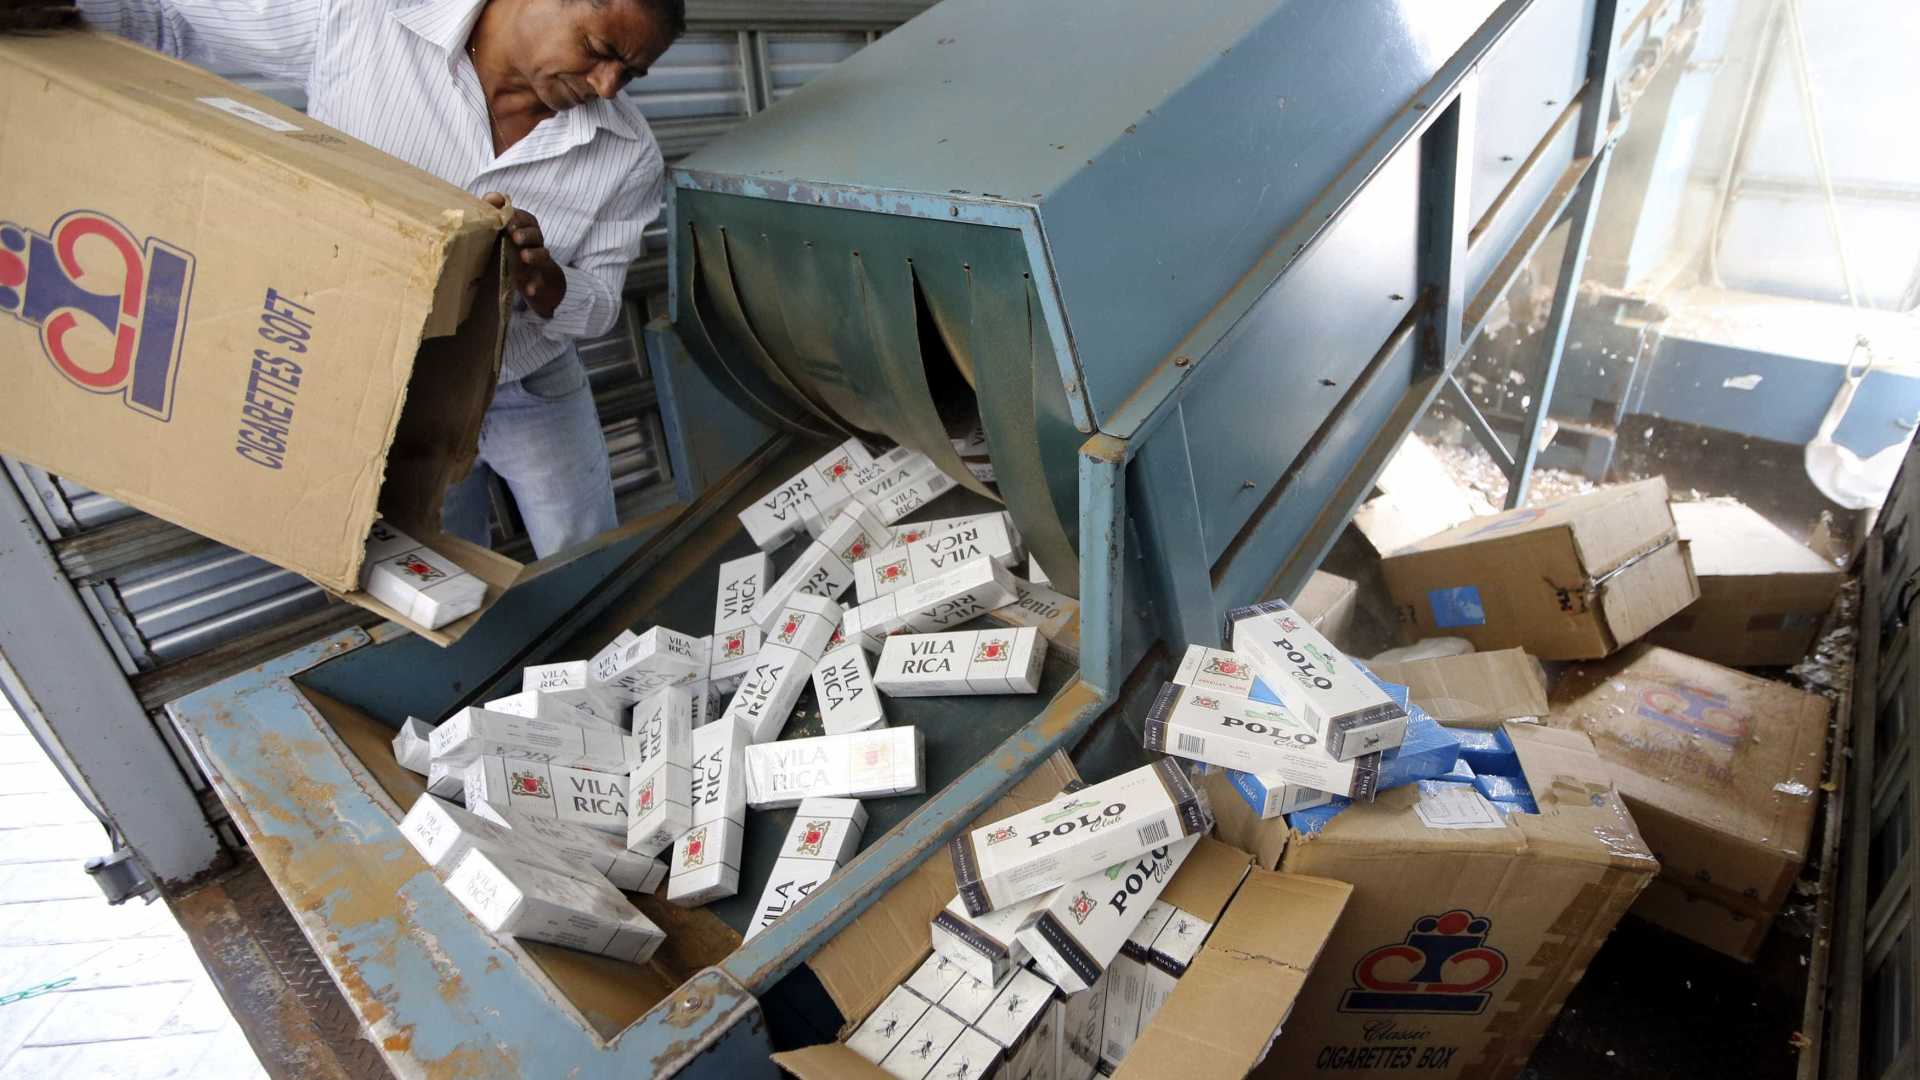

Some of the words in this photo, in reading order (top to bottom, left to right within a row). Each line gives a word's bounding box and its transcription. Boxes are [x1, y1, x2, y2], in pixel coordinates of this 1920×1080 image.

[258, 287, 316, 353] SOFT
[235, 349, 303, 470] CIGARETTES
[854, 463, 881, 478] VILA
[858, 468, 886, 486] RICA
[868, 469, 911, 496] VILA
[764, 478, 809, 510] RICA
[890, 488, 919, 506] VILA
[896, 496, 924, 516] RICA
[926, 528, 979, 552] RICA
[930, 544, 981, 568] VILA
[723, 580, 739, 620] VILA
[741, 574, 757, 615] RICA
[921, 594, 977, 617] RICA
[932, 604, 985, 625] VILA
[668, 636, 692, 649] VILA
[668, 644, 692, 657] RICA
[909, 639, 956, 656] VILA
[599, 652, 619, 670] VILA
[901, 658, 951, 674] RICA
[1272, 637, 1333, 690] POLO
[540, 679, 569, 689] RICA
[541, 669, 569, 679] VILA
[734, 663, 770, 709] VILA
[841, 657, 864, 701] VILA
[747, 665, 784, 717] RICA
[820, 666, 845, 711] RICA
[650, 706, 663, 760] RICA
[1220, 716, 1317, 745] POLO
[1273, 738, 1307, 751] Club
[774, 747, 832, 769] VILA
[570, 776, 625, 797] VILA
[691, 754, 707, 807] VILA
[705, 746, 724, 804] RICA
[772, 769, 831, 791] RICA
[573, 796, 629, 817] RICA
[1188, 806, 1200, 827] SUAVE
[1026, 803, 1126, 847] POLO
[1089, 815, 1121, 833] Club
[1108, 845, 1169, 917] POLO
[1153, 855, 1174, 884] Club
[761, 880, 795, 927] ILA
[1363, 1020, 1430, 1041] Classic
[1316, 1045, 1415, 1070] CIGARETTES
[1416, 1046, 1458, 1069] BOX
